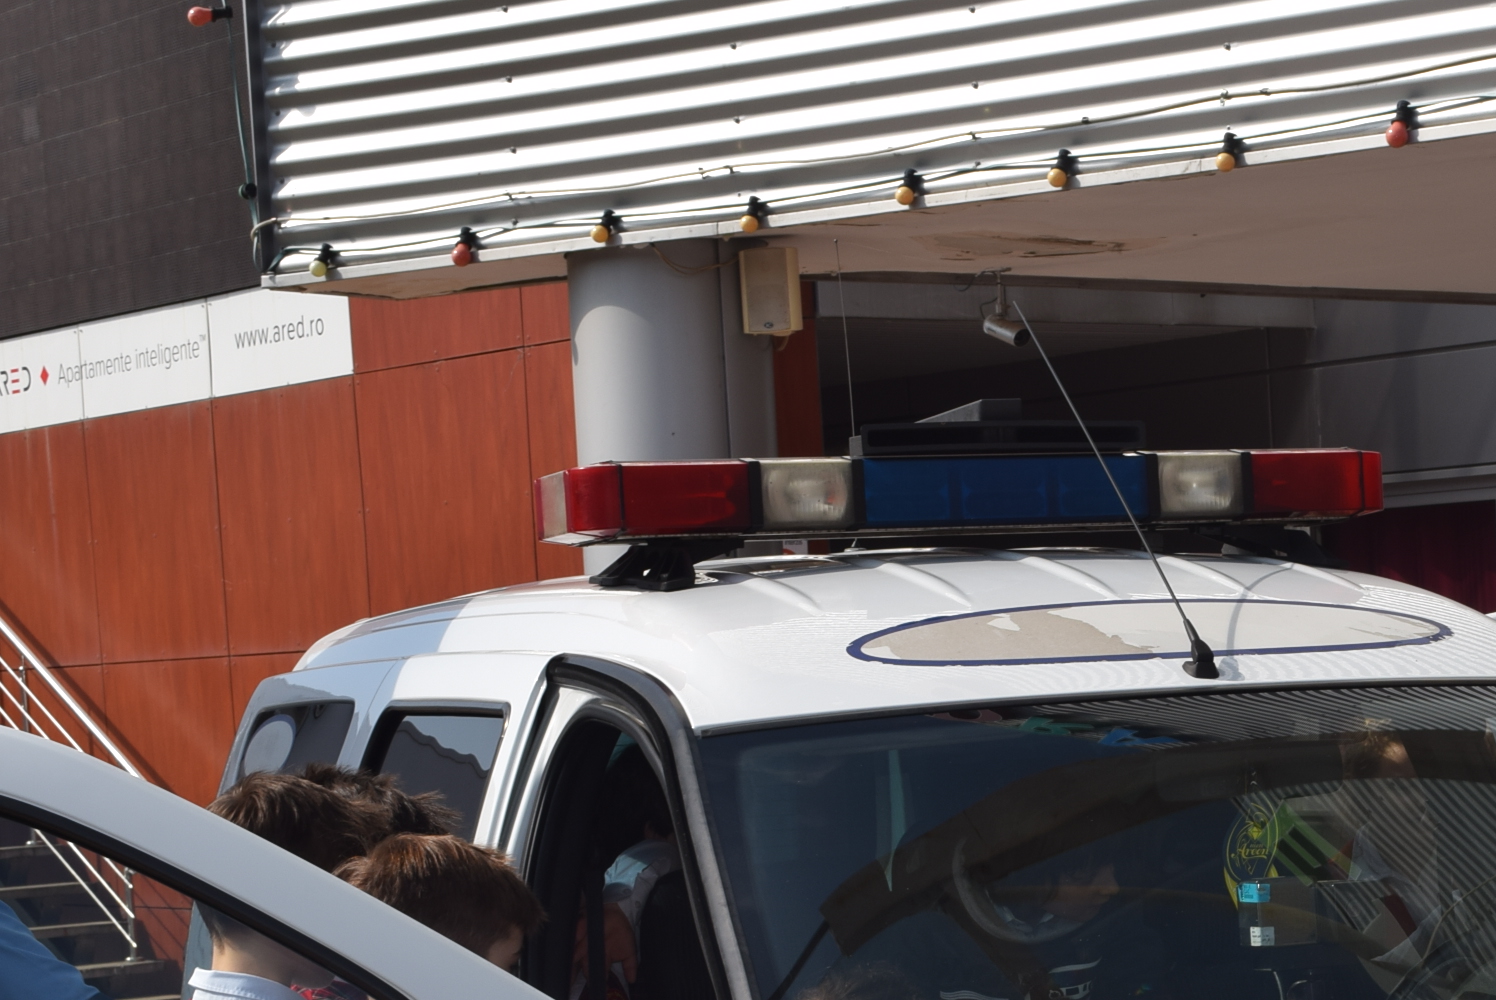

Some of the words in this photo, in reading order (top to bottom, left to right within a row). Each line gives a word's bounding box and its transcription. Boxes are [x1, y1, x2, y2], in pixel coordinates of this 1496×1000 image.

[234, 315, 325, 349] www.ared.ro
[0, 366, 32, 397] RED
[57, 352, 133, 388] Apartamente
